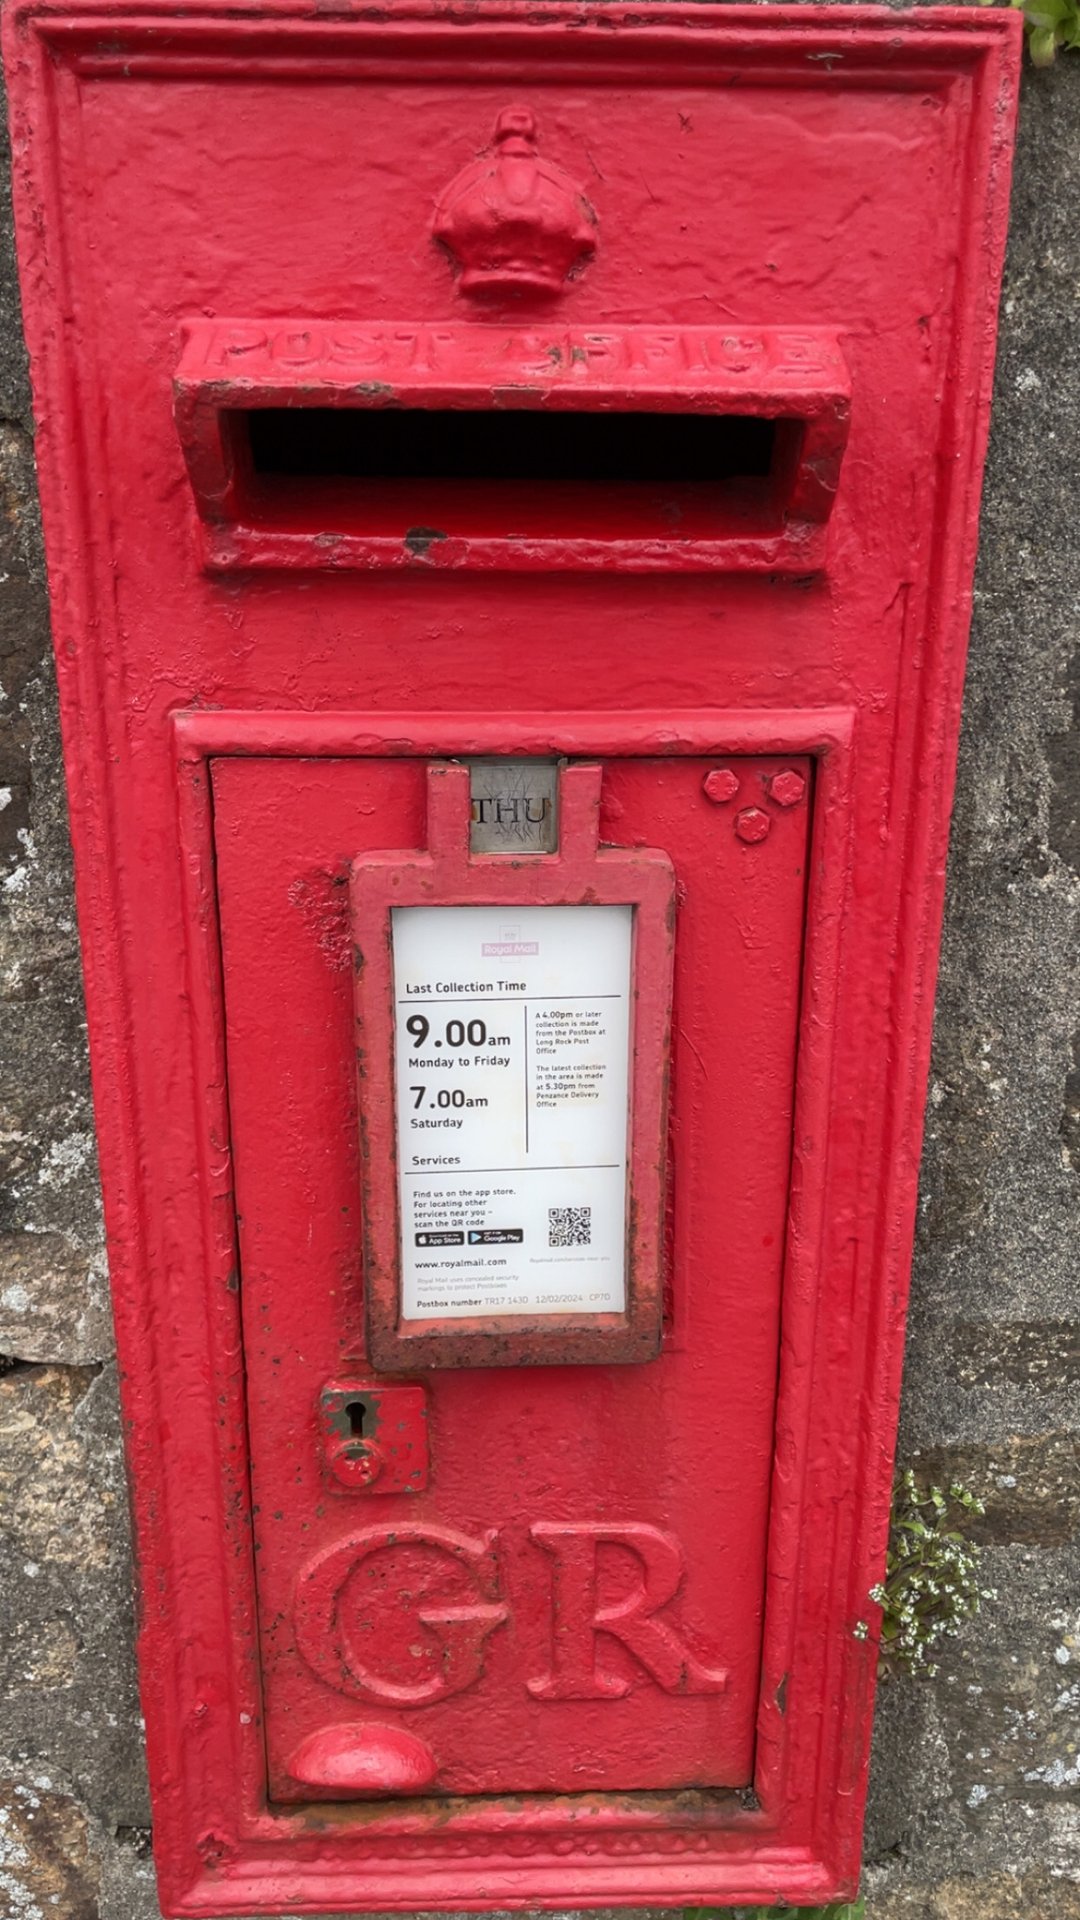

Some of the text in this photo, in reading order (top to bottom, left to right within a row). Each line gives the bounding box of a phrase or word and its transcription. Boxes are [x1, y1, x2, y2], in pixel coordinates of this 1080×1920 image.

[203, 326, 455, 373] POST
[471, 798, 551, 824] THU
[484, 943, 537, 955] Royal Mail
[406, 981, 526, 994] Last Collection Time
[542, 1011, 573, 1020] 4.00pm
[536, 1020, 569, 1028] collection
[406, 1014, 511, 1048] 9.00am
[536, 1029, 553, 1037] from
[536, 1047, 557, 1055] Office
[408, 1056, 510, 1069] Monday to Friday
[545, 1083, 576, 1091] 5.30pm
[410, 1086, 488, 1109] 7.00am
[411, 1118, 463, 1129] Saturday
[412, 1155, 461, 1166] Services
[475, 1189, 490, 1197] app
[429, 1200, 463, 1208] locating
[464, 1199, 487, 1207] other
[414, 1210, 447, 1218] services
[428, 1237, 442, 1245] App
[483, 1234, 520, 1243] Google Play
[414, 1258, 507, 1269] www.royalmail.com
[417, 1299, 449, 1308] Postbox
[450, 1298, 482, 1306] number
